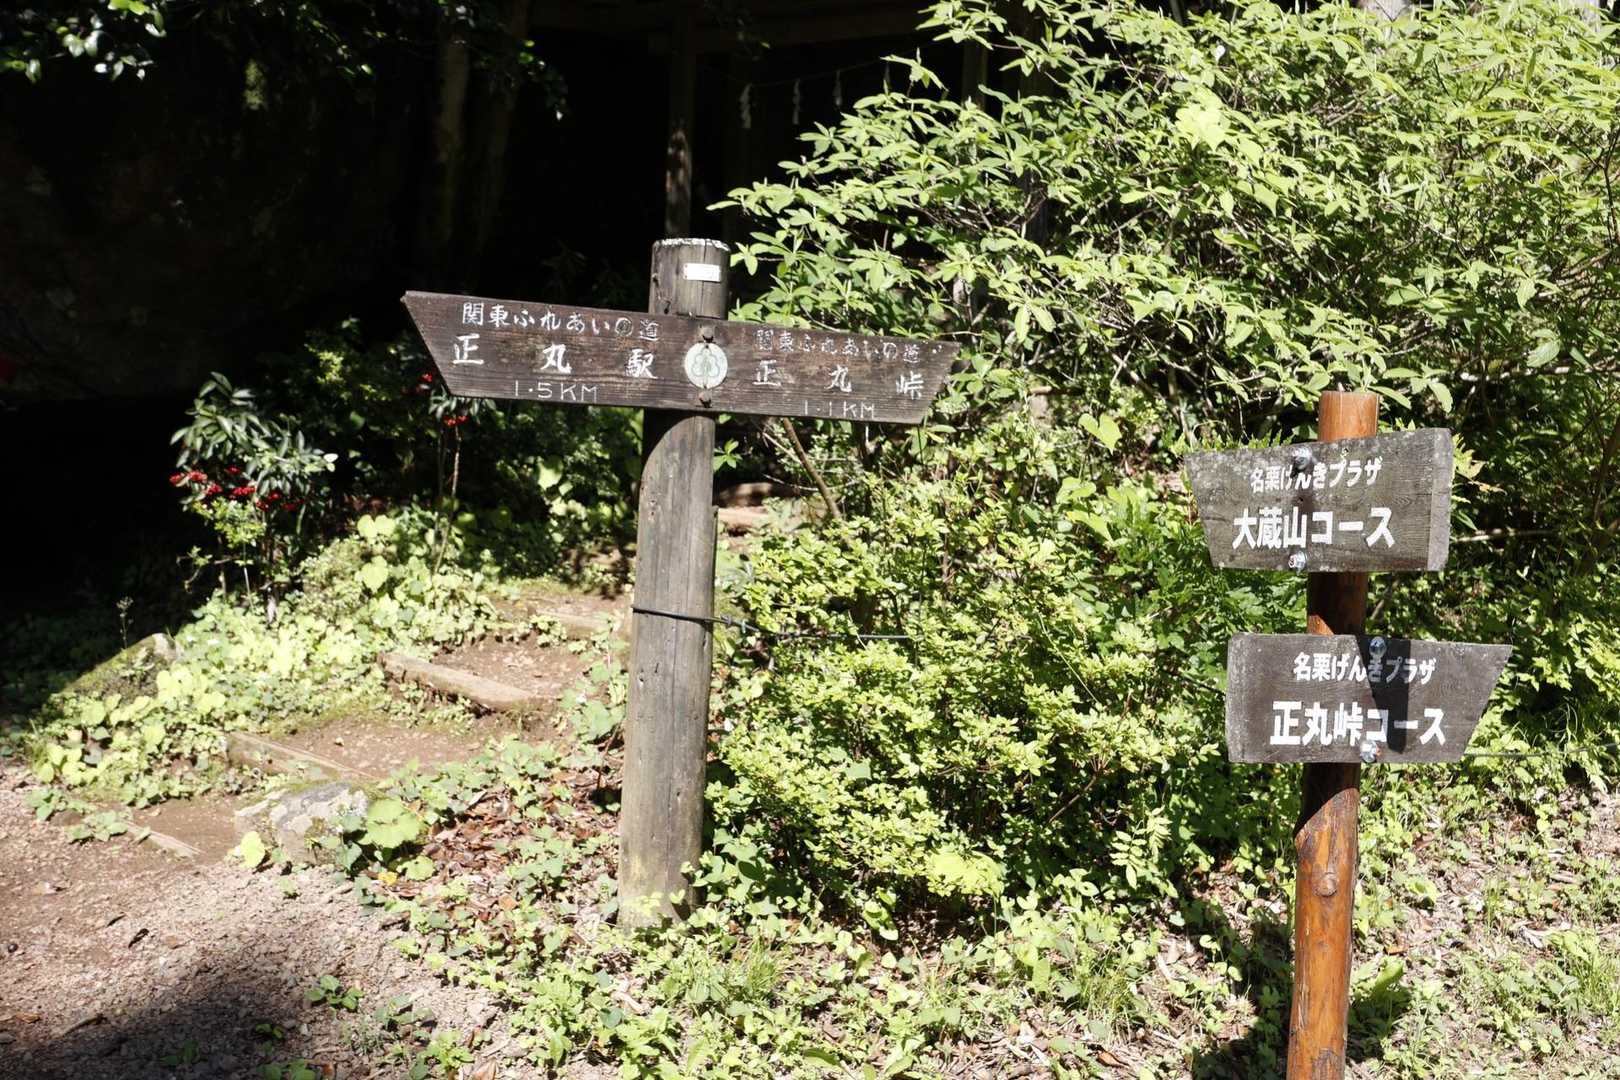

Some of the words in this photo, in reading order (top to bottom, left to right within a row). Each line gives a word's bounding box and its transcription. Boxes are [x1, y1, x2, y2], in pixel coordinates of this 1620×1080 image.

[453, 333, 658, 379] 正丸駅
[752, 359, 924, 400] 正丸峠
[1232, 506, 1396, 549] 大蔵山コース
[1293, 652, 1437, 685] 名栗げんきプラザ
[1269, 700, 1446, 747] 正丸峠コース
